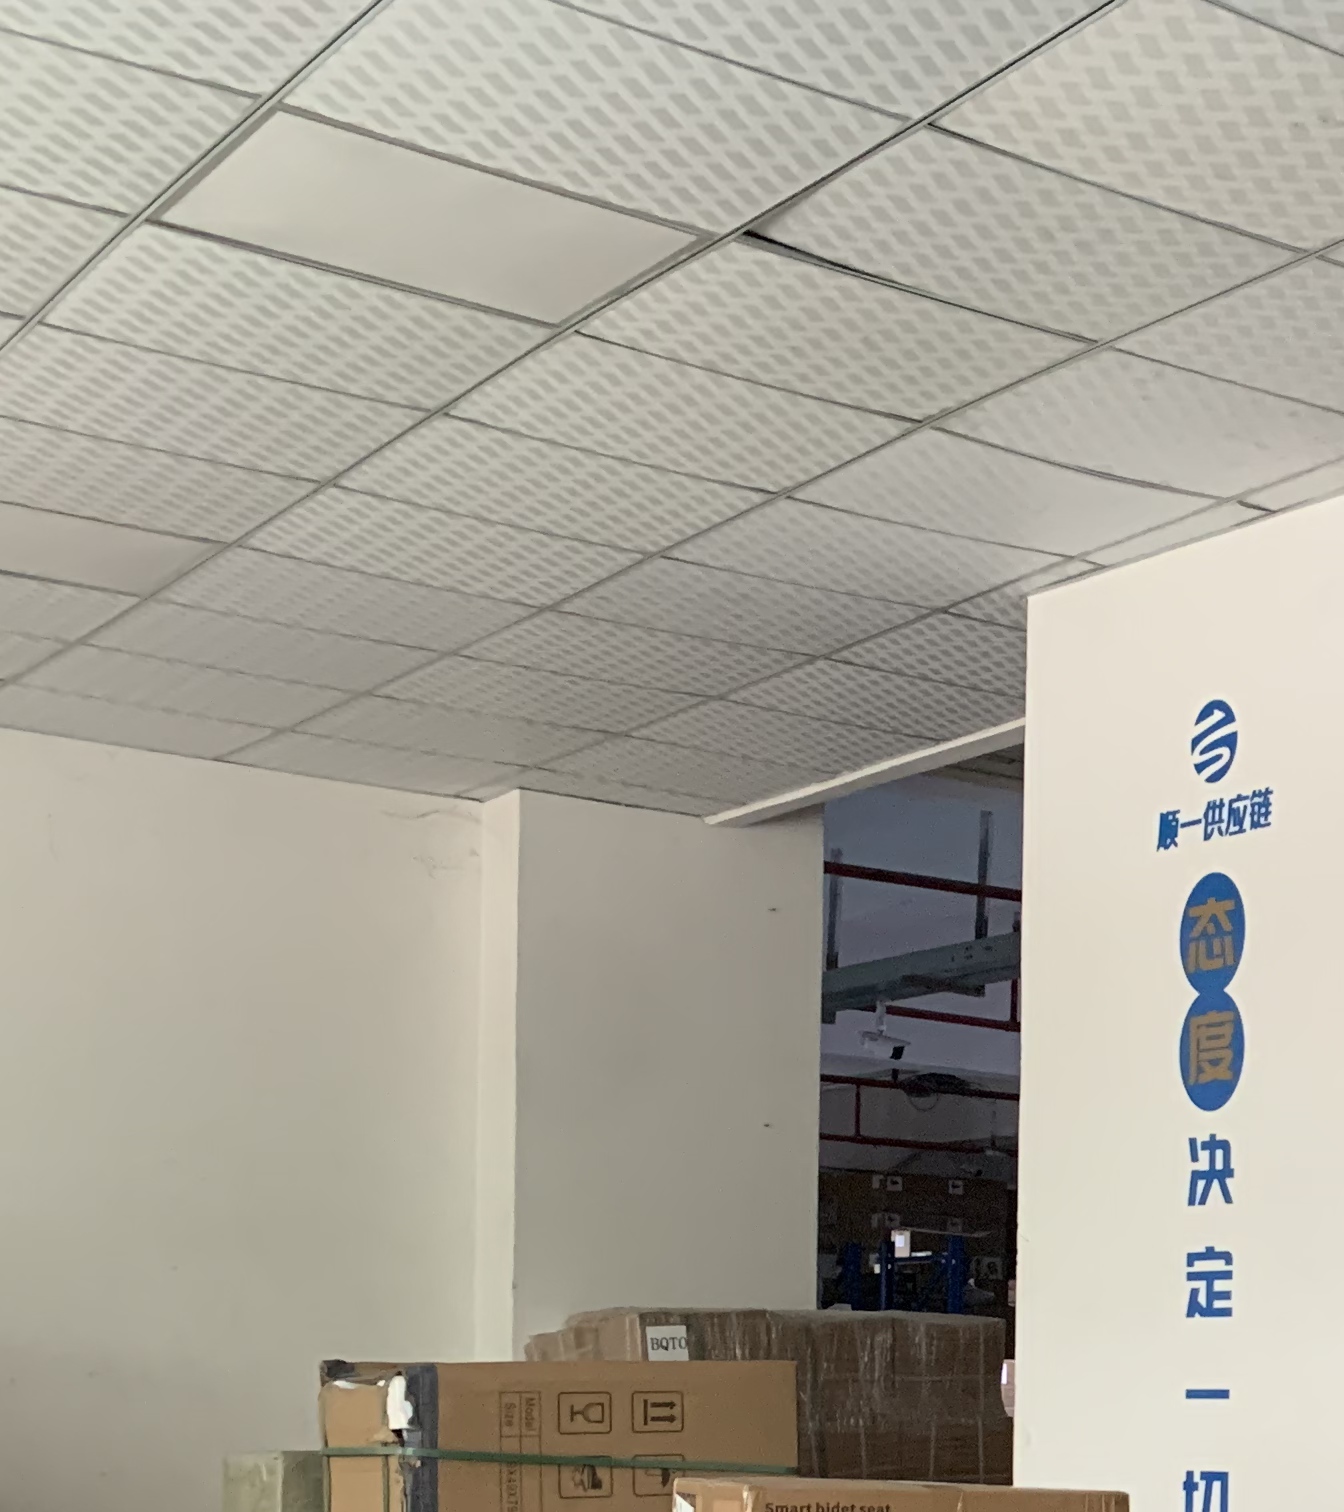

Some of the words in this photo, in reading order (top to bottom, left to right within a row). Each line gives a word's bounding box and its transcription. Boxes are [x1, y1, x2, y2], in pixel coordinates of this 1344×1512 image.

[1156, 786, 1273, 851] 顺一供应链
[650, 1334, 689, 1352] BQTO
[504, 1402, 517, 1428] Size
[523, 1397, 537, 1432] Model
